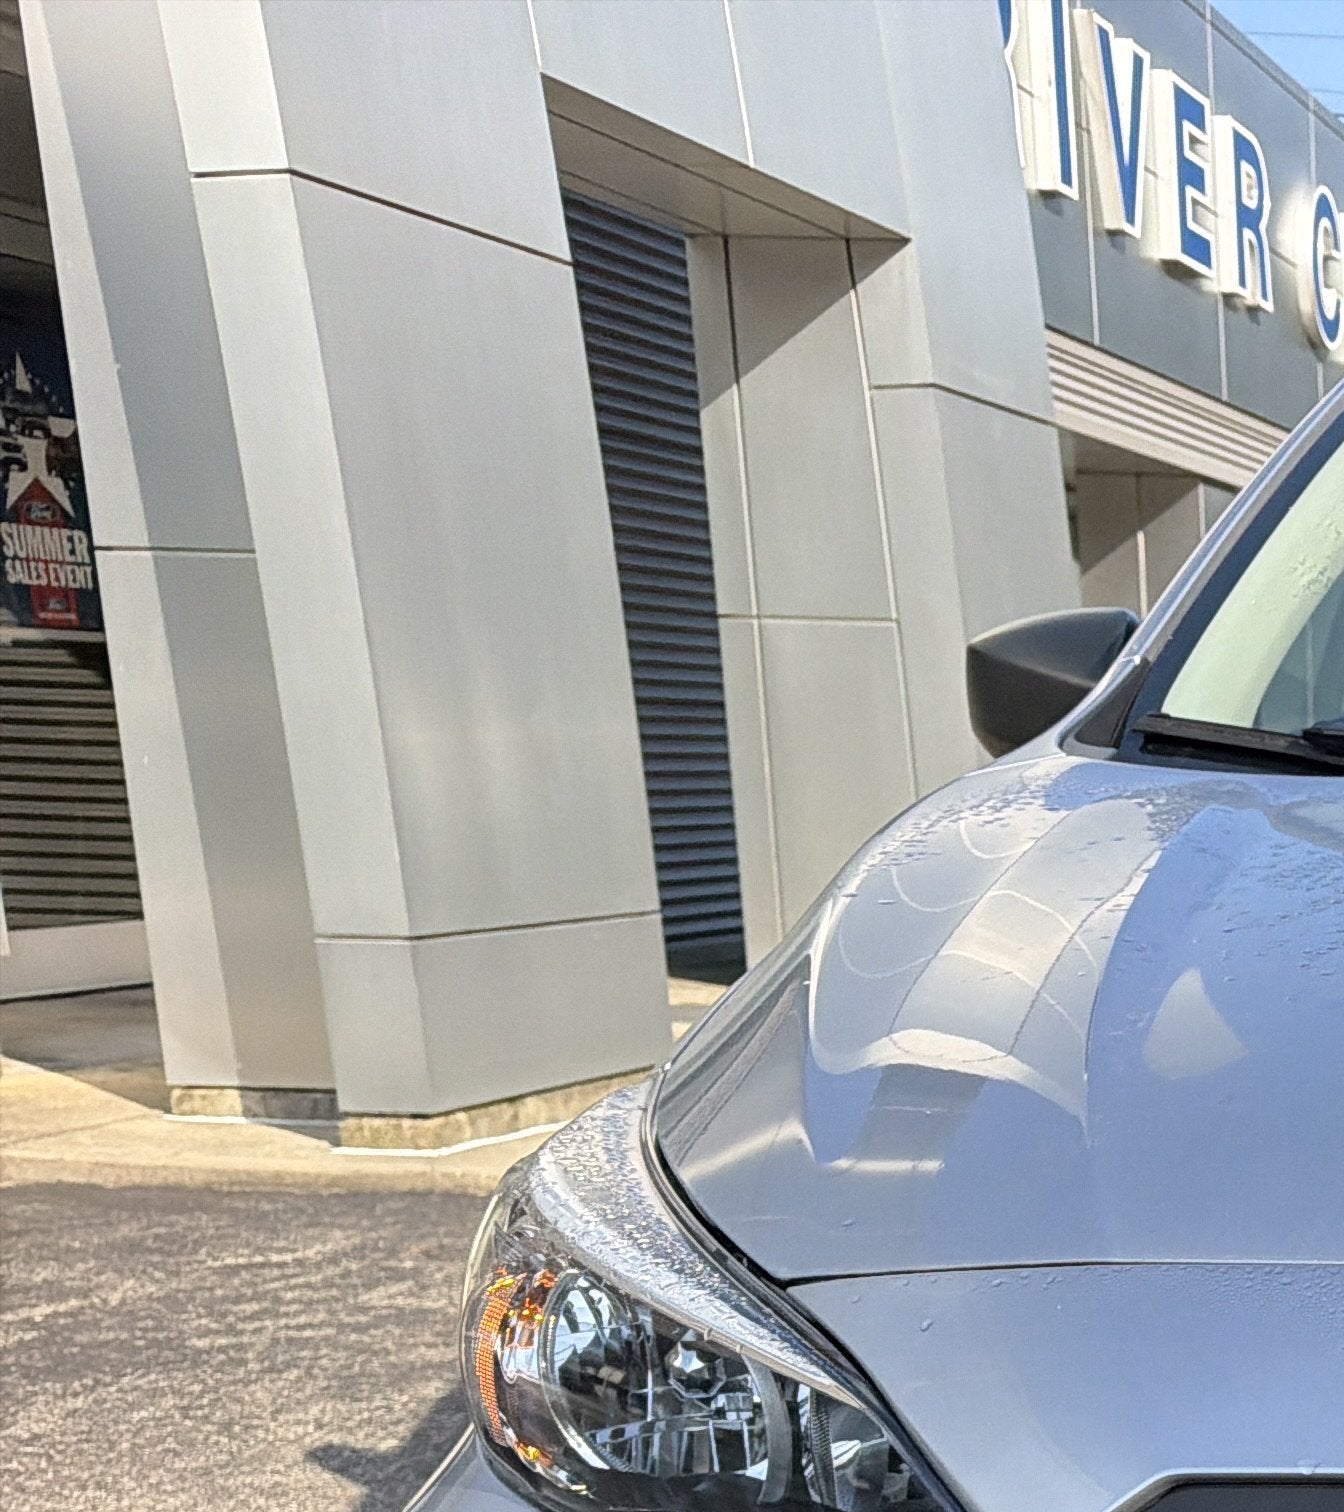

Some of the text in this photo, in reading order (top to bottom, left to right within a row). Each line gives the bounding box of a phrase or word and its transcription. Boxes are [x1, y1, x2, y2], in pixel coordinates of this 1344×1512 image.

[998, 0, 1274, 313] IVER
[0, 521, 91, 564] SUMMER
[5, 560, 94, 590] SALES EVENT
